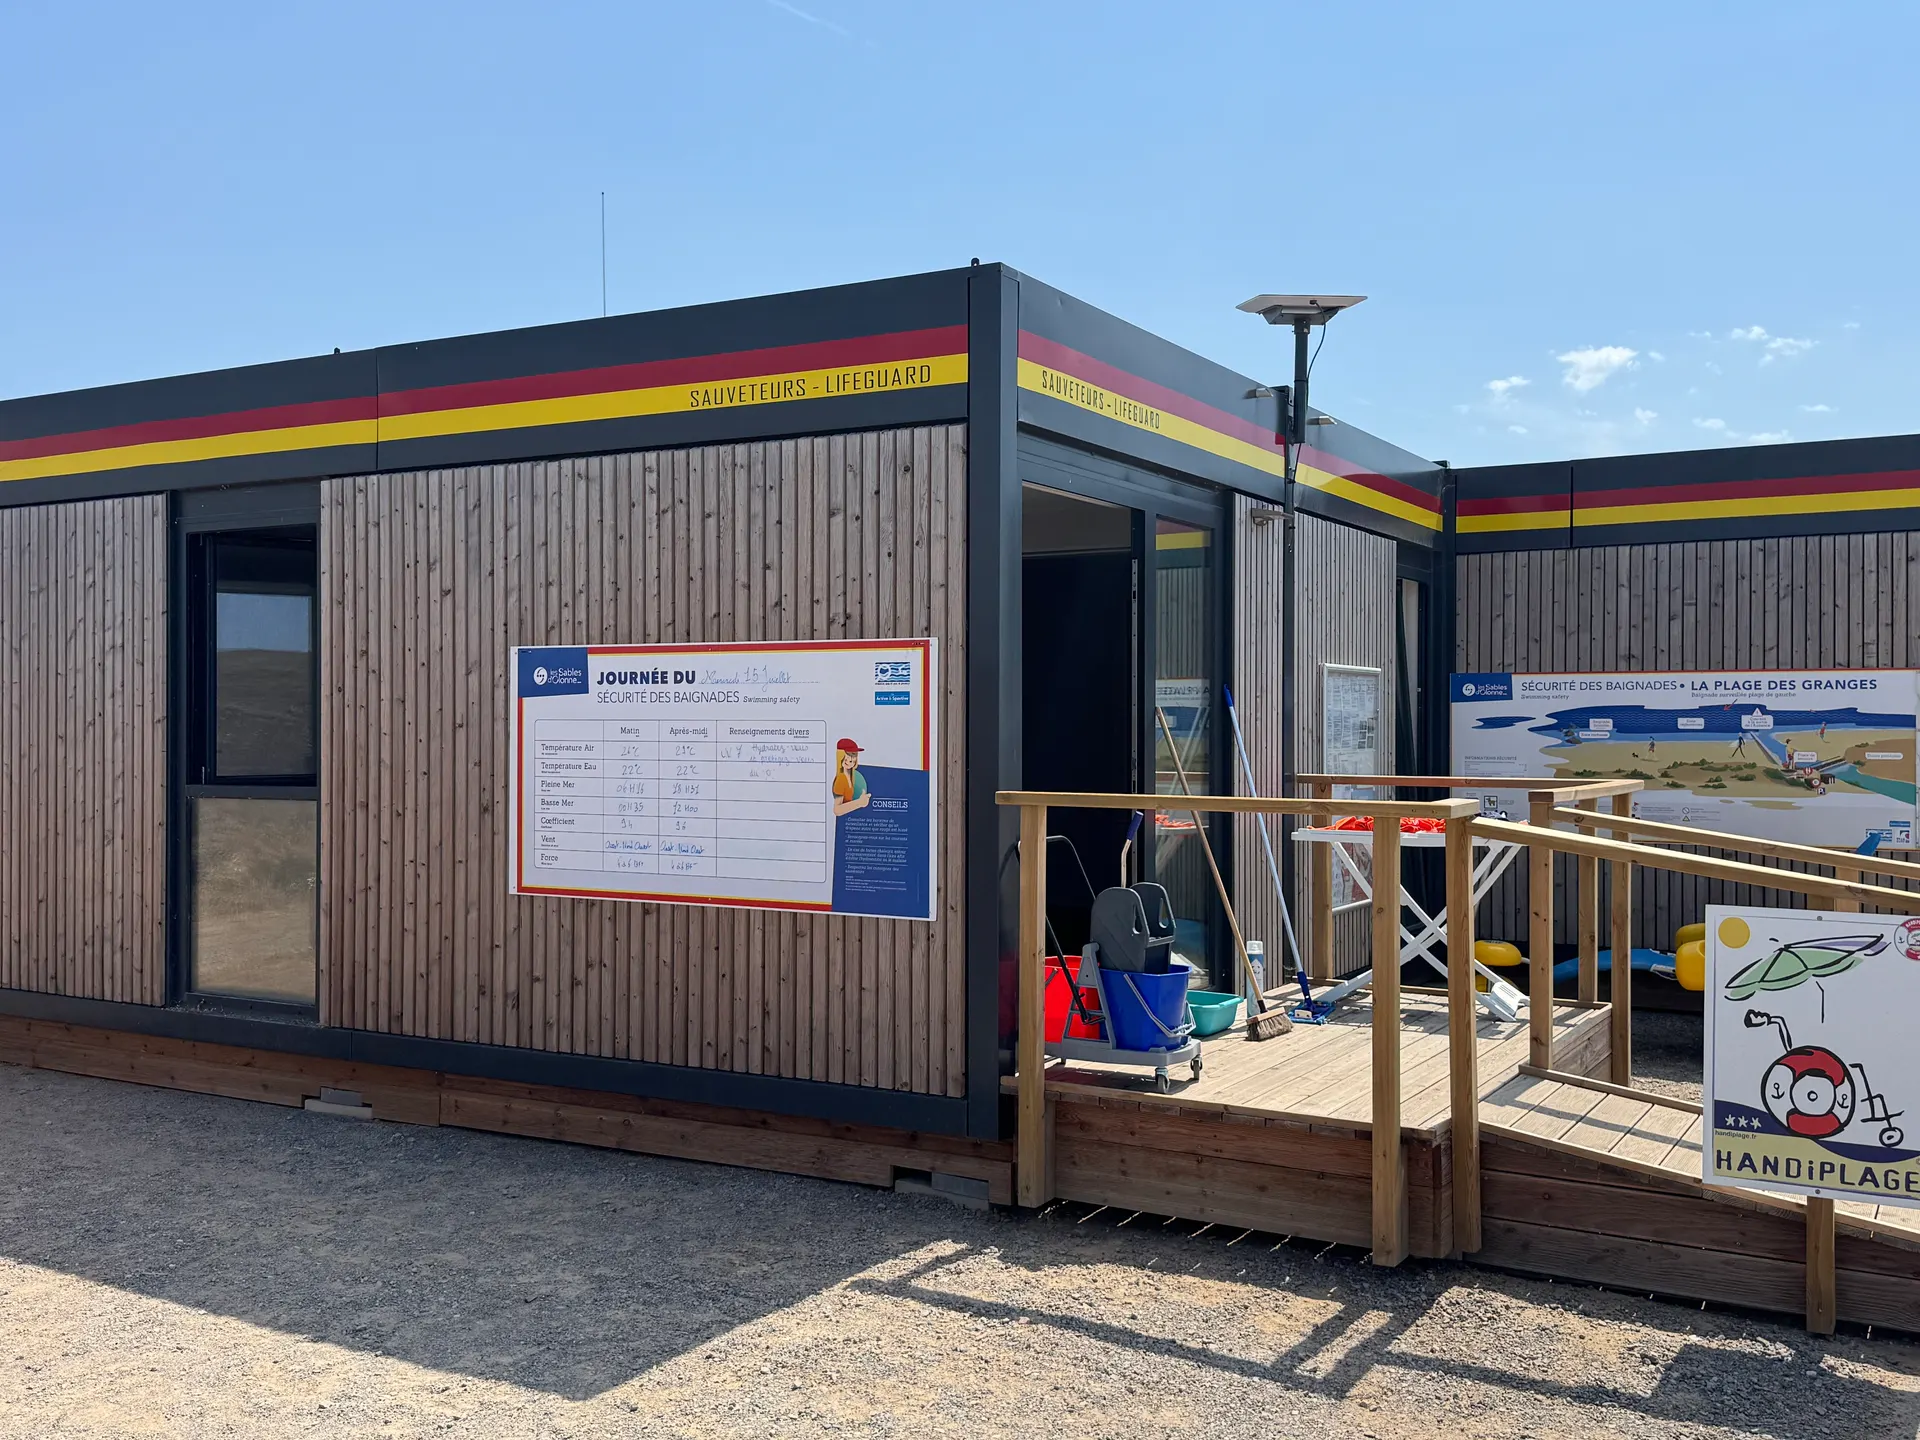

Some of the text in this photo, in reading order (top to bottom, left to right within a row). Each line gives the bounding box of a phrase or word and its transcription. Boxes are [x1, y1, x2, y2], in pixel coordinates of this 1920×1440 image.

[690, 378, 807, 408] SAUVETEURS
[826, 364, 931, 393] LIFEGUARD
[1042, 370, 1104, 410] SAUVETEURS
[1114, 398, 1160, 429] LIFEGUARD
[558, 667, 582, 677] Sables
[597, 667, 696, 685] JOURNÉE DU
[1521, 679, 1878, 692] SÉCURITÉ DES BAIGNADES LA PLAGE DES GRANGES
[597, 689, 800, 705] SÉCURITÉ DES BAIGNADES Swimming safety
[620, 726, 640, 735] Matin
[669, 727, 708, 736] Après-midi
[729, 727, 786, 737] Renseignements
[787, 727, 810, 736] divers
[584, 744, 595, 752] Air
[541, 780, 575, 788] Pleine Mer
[541, 799, 574, 807] Basse Mer
[872, 801, 909, 809] CONSEILS
[541, 835, 556, 843] Vent
[540, 853, 559, 861] Force
[1714, 1130, 1757, 1140] handiplage.fr
